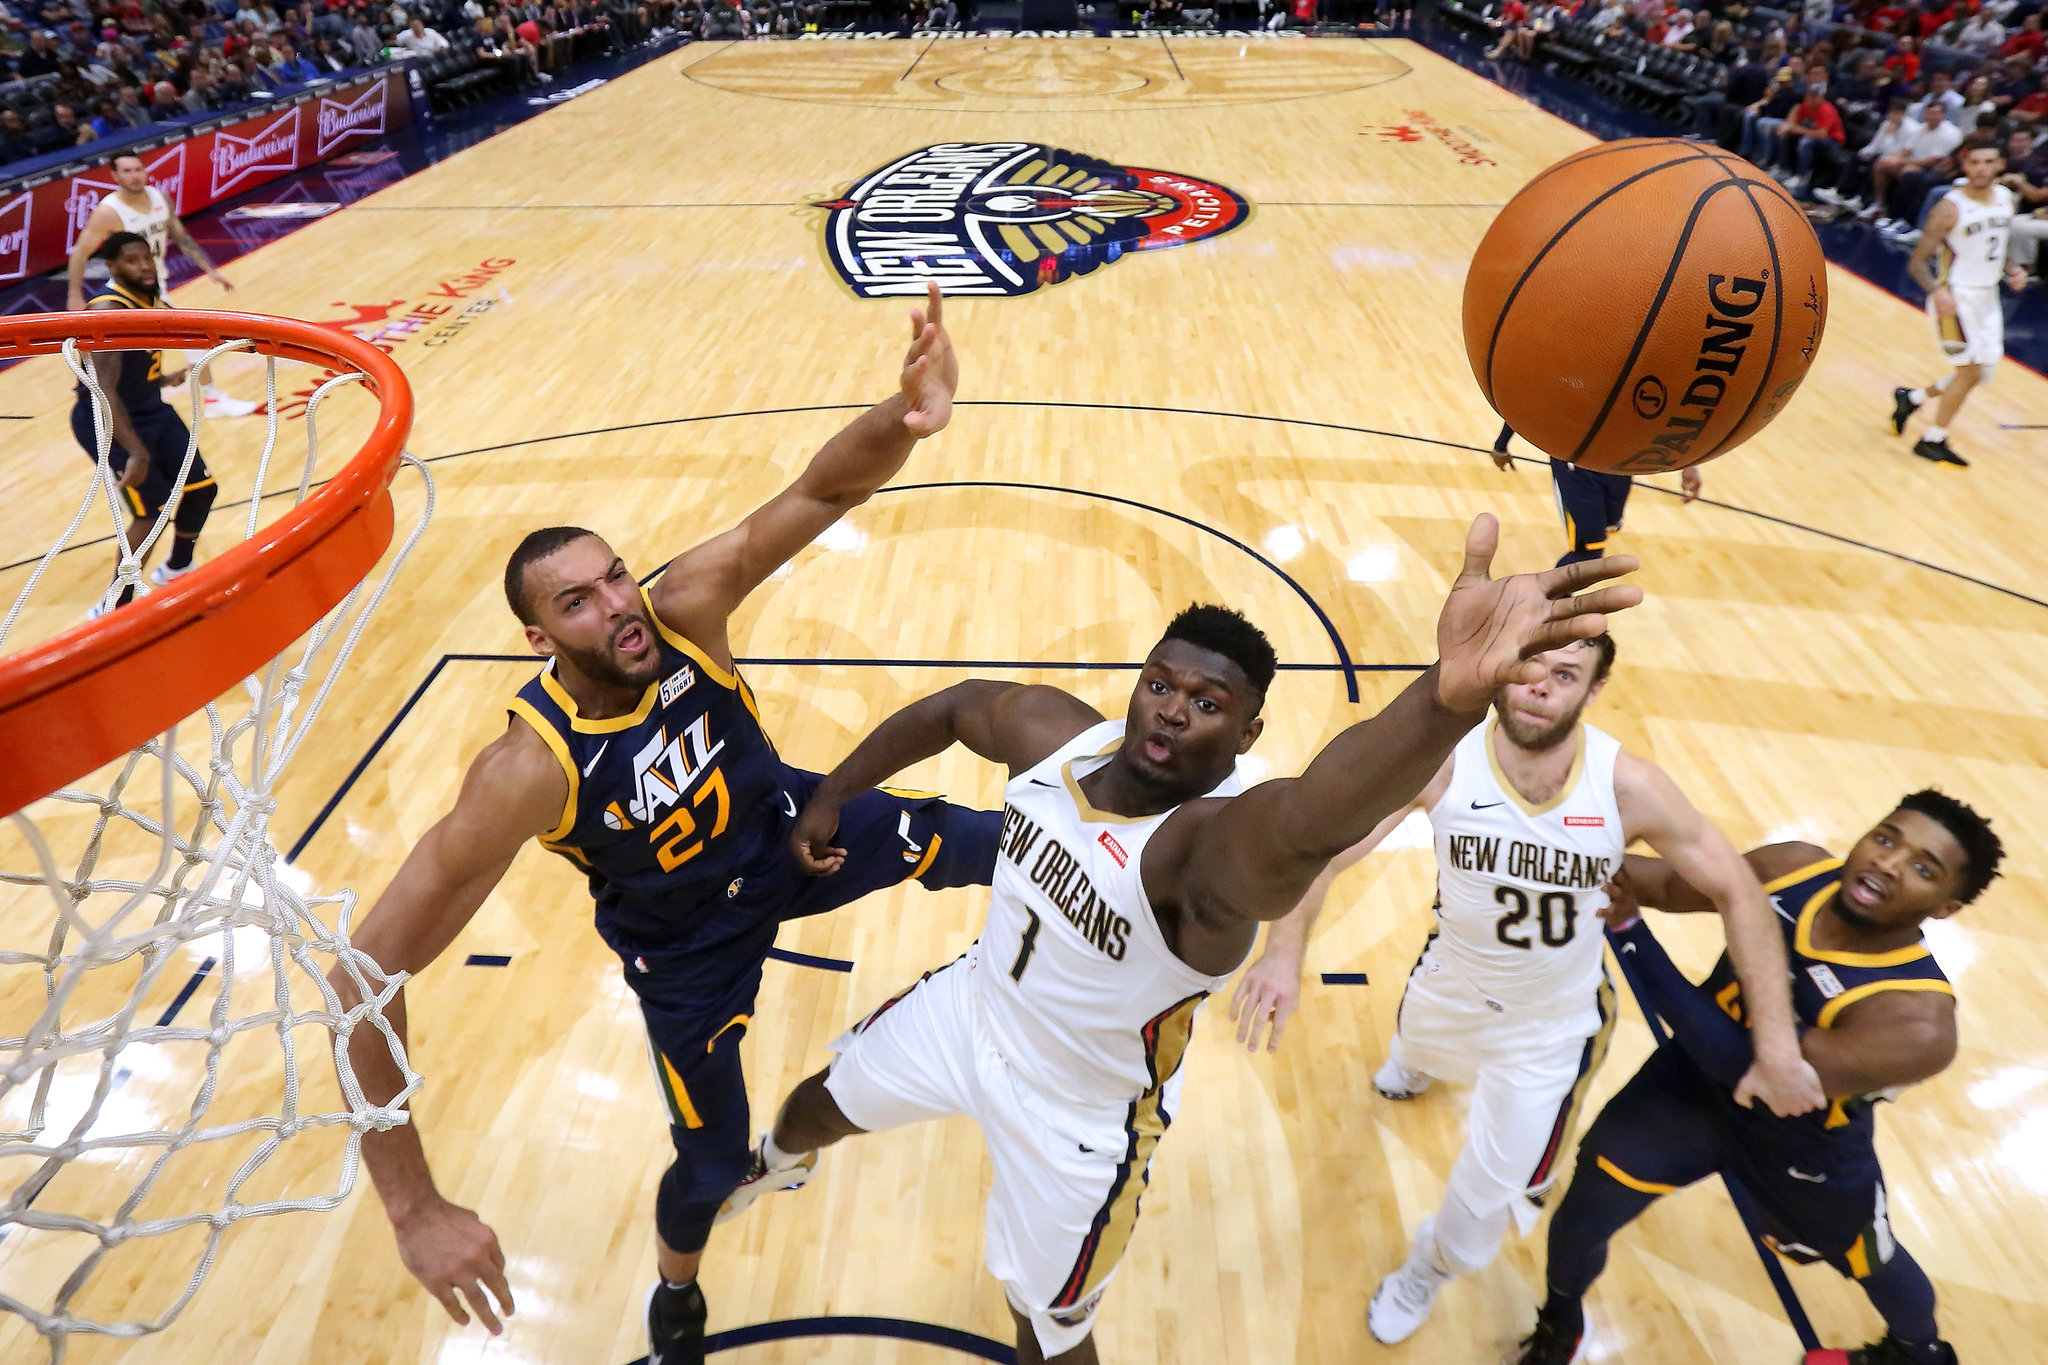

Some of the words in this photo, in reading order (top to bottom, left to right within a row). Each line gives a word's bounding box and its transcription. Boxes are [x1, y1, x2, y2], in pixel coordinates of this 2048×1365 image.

[912, 30, 1094, 39] ORLEANS
[1110, 29, 1306, 38] PELICANS
[317, 101, 383, 138] Budweiser
[210, 133, 296, 177] Budweiser
[856, 143, 1028, 223] ORLEANS
[1149, 175, 1222, 236] PELICANS
[853, 229, 1008, 296] NEW
[661, 683, 671, 703] 5
[673, 675, 692, 696] FIGHT
[629, 711, 725, 825] JAZZ
[649, 766, 731, 874] 27
[1450, 835, 1503, 873] NEW
[1508, 840, 1612, 889] ORLEANS
[1030, 839, 1133, 963] ORLEANS
[1493, 885, 1579, 951] 20
[1008, 905, 1042, 986] 1
